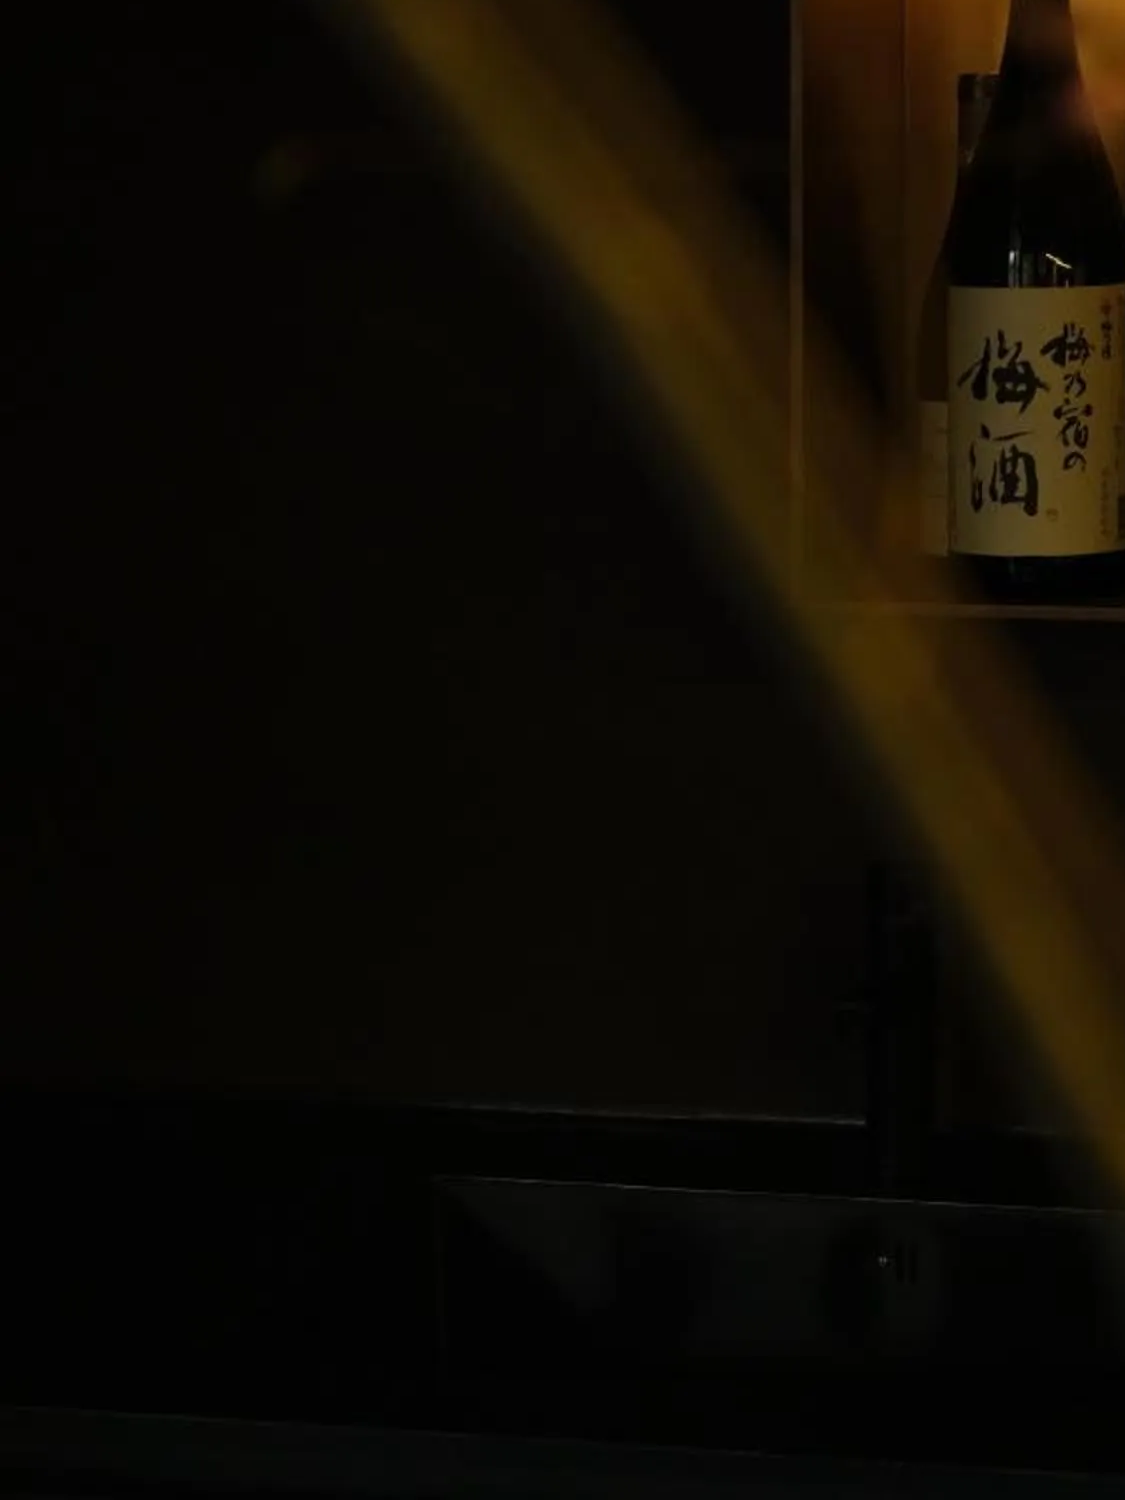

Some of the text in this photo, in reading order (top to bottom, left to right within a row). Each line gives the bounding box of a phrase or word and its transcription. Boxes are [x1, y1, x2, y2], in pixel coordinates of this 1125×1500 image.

[957, 329, 1050, 518] 梅酒
[1040, 322, 1097, 472] 梅乃宿の
